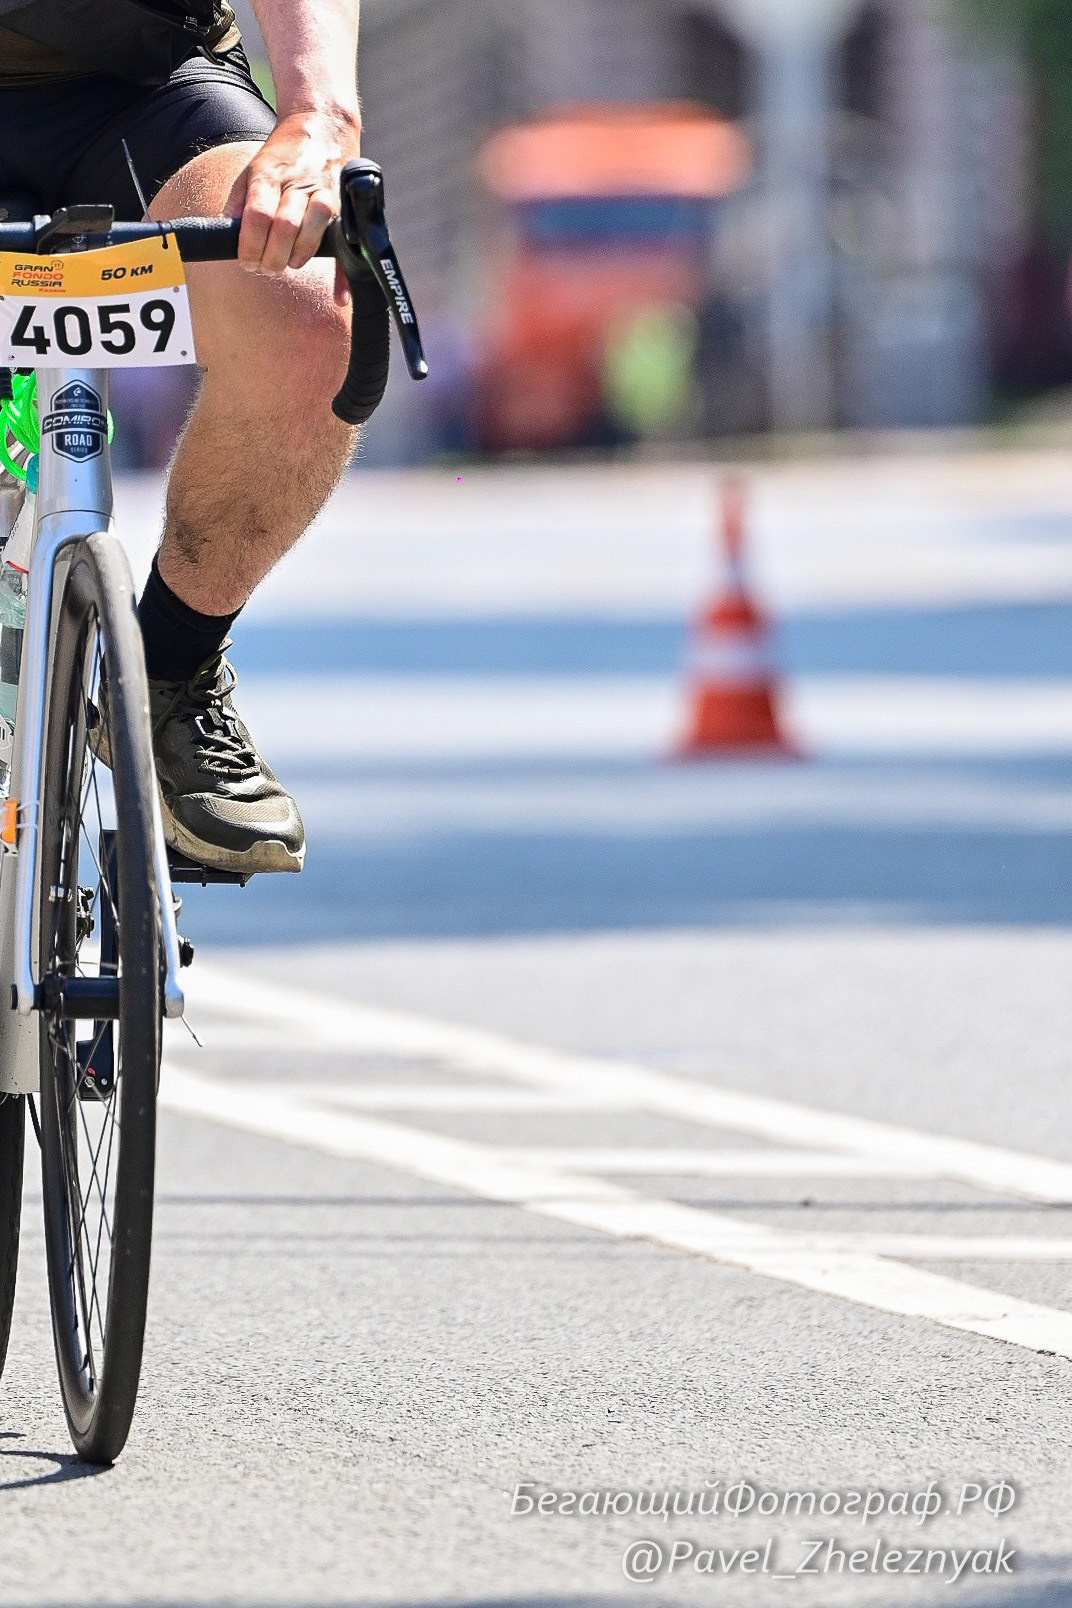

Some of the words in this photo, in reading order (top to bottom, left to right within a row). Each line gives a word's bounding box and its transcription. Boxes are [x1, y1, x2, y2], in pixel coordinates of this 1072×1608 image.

[14, 264, 54, 272] GRAN
[100, 267, 127, 281] 50
[11, 278, 63, 287] RUSSIA
[12, 271, 64, 280] FONDO
[380, 258, 414, 325] EMPIRE
[10, 299, 176, 356] 4059
[64, 433, 93, 447] ROAD
